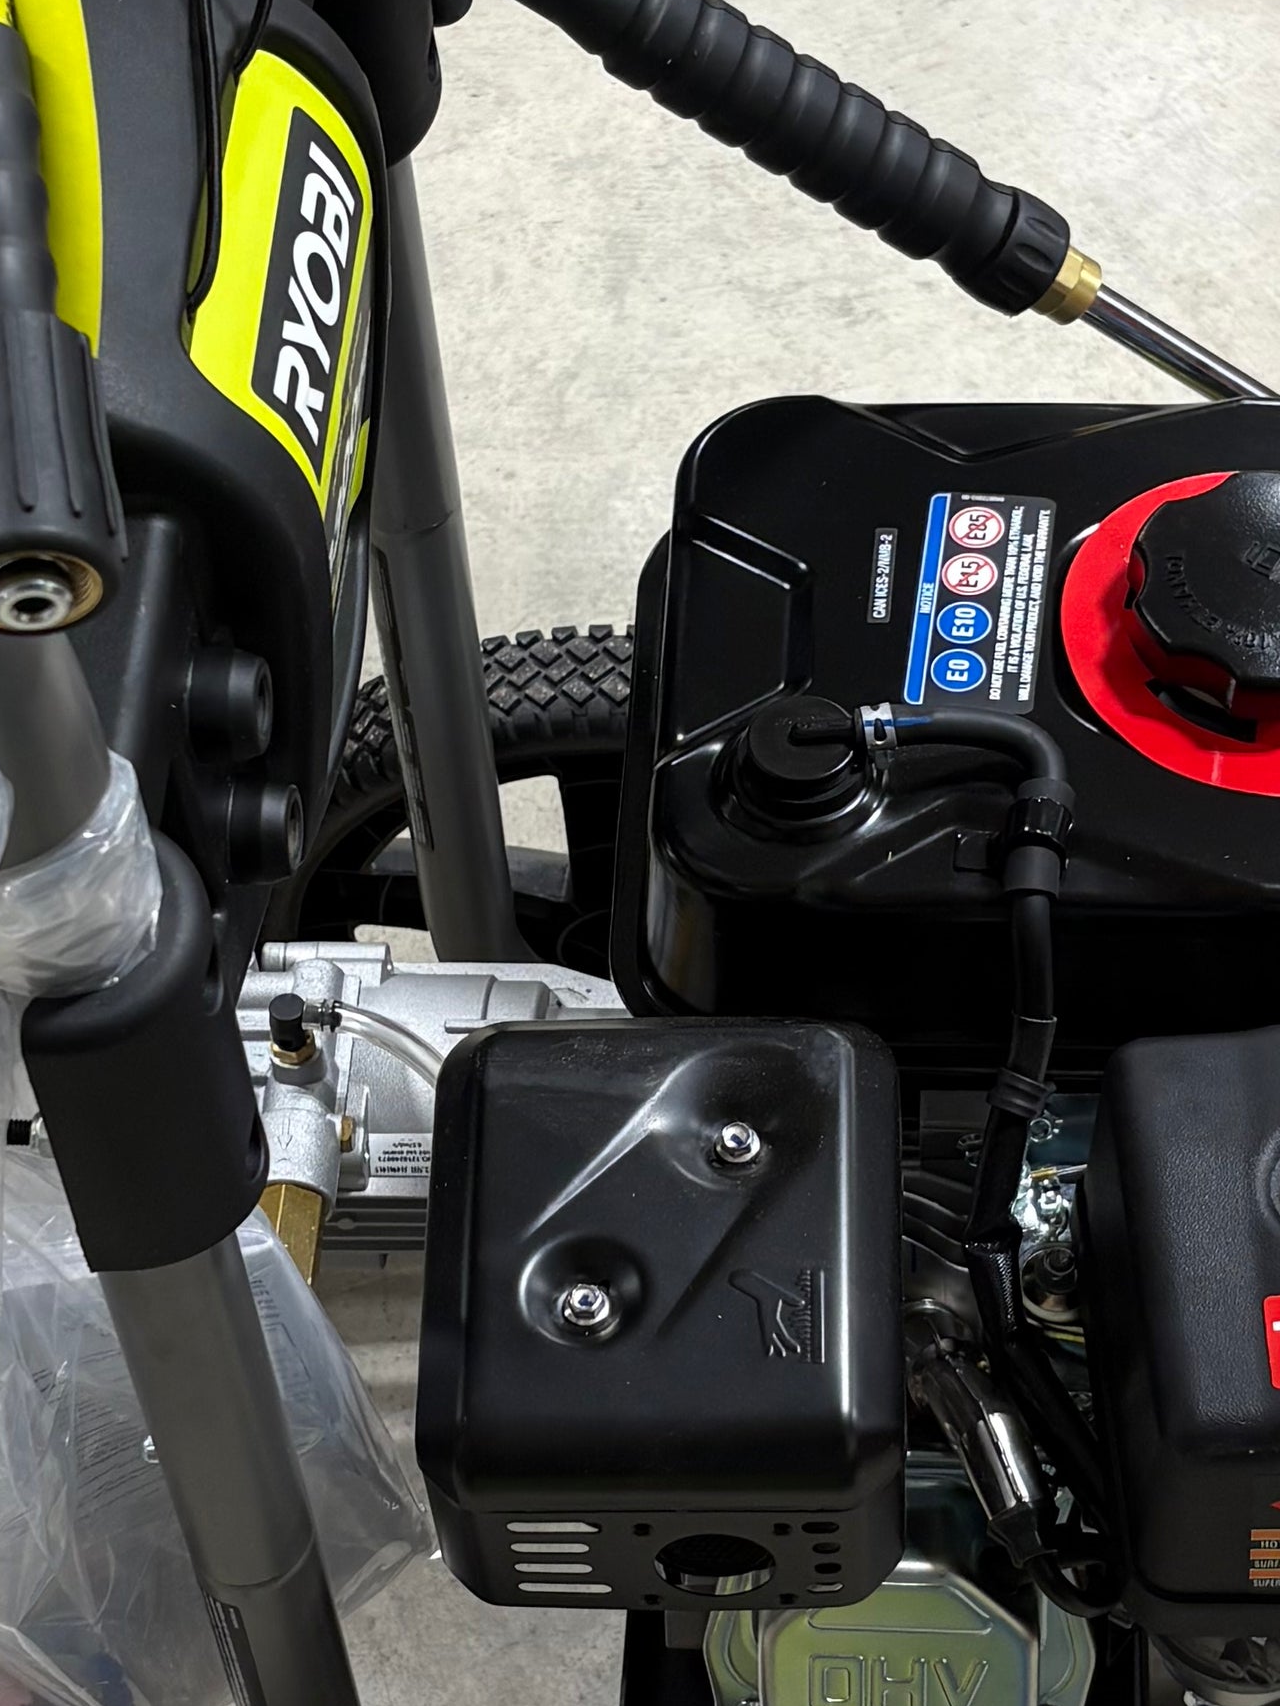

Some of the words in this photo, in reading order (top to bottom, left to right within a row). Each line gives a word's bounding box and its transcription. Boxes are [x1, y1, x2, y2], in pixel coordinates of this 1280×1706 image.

[272, 140, 356, 447] RYOBI
[966, 512, 990, 542] E85
[958, 560, 982, 590] E15
[872, 599, 887, 618] CAN
[919, 582, 935, 614] NOTICE
[951, 607, 978, 638] E10
[945, 658, 971, 682] E0
[992, 659, 1004, 672] USE
